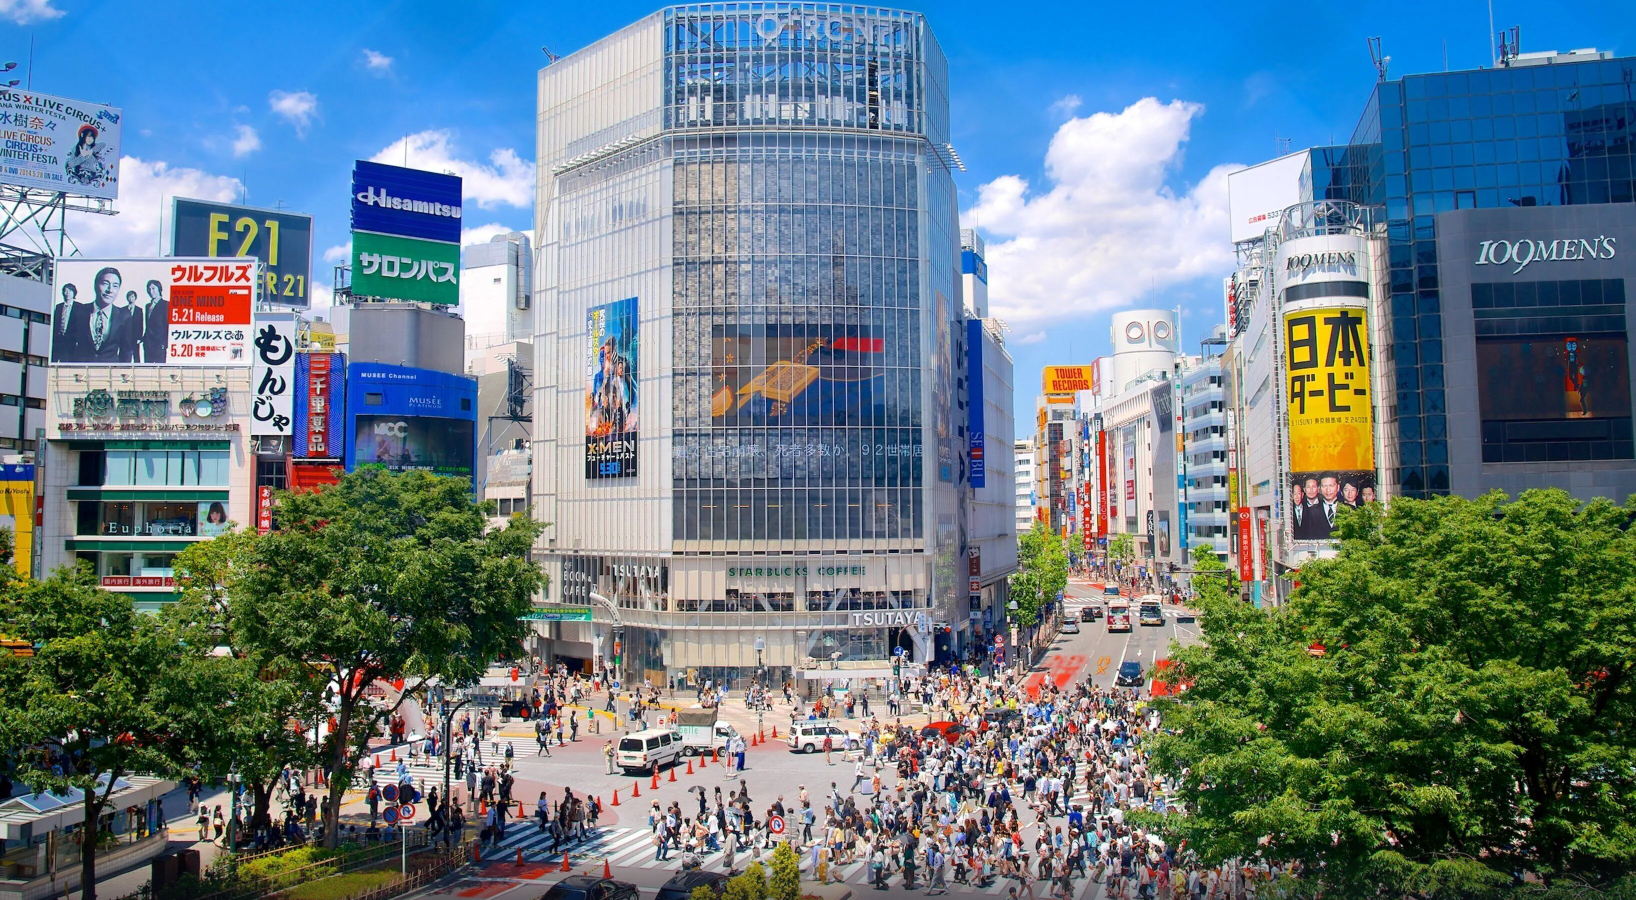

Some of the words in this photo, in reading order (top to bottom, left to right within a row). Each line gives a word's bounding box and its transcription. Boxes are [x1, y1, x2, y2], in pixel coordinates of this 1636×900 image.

[36, 98, 64, 112] LIVE
[15, 105, 44, 114] WINTER
[45, 109, 66, 121] FESTA
[0, 111, 57, 131] 水樹奈々
[32, 154, 58, 165] FESTA
[52, 173, 63, 181] SALE
[357, 186, 461, 218] Hisamitsu
[171, 264, 252, 282] ウルフルズ
[360, 252, 457, 284] サロンパス
[284, 274, 304, 298] 21
[172, 296, 193, 307] ONE
[196, 296, 225, 307] MIND
[172, 308, 193, 322] 5.21
[195, 312, 225, 322] Release
[171, 330, 244, 341] ウルフルズぴあ
[1288, 311, 1366, 371] 日本
[170, 344, 193, 357] 5.20
[253, 324, 293, 432] もんじゃ
[1055, 368, 1083, 379] TOWER
[1052, 380, 1089, 390] RECORDS
[1290, 372, 1366, 415] ダービー
[309, 356, 327, 452] 三千里薬品
[970, 431, 983, 477] SEIBU
[109, 522, 193, 534] Euphoria
[613, 565, 660, 578] TSUTAYA
[728, 567, 808, 577] STARBUCKS
[818, 566, 866, 576] COFFEE
[563, 584, 586, 597] CAFE
[852, 611, 921, 626] TSUTAYA
